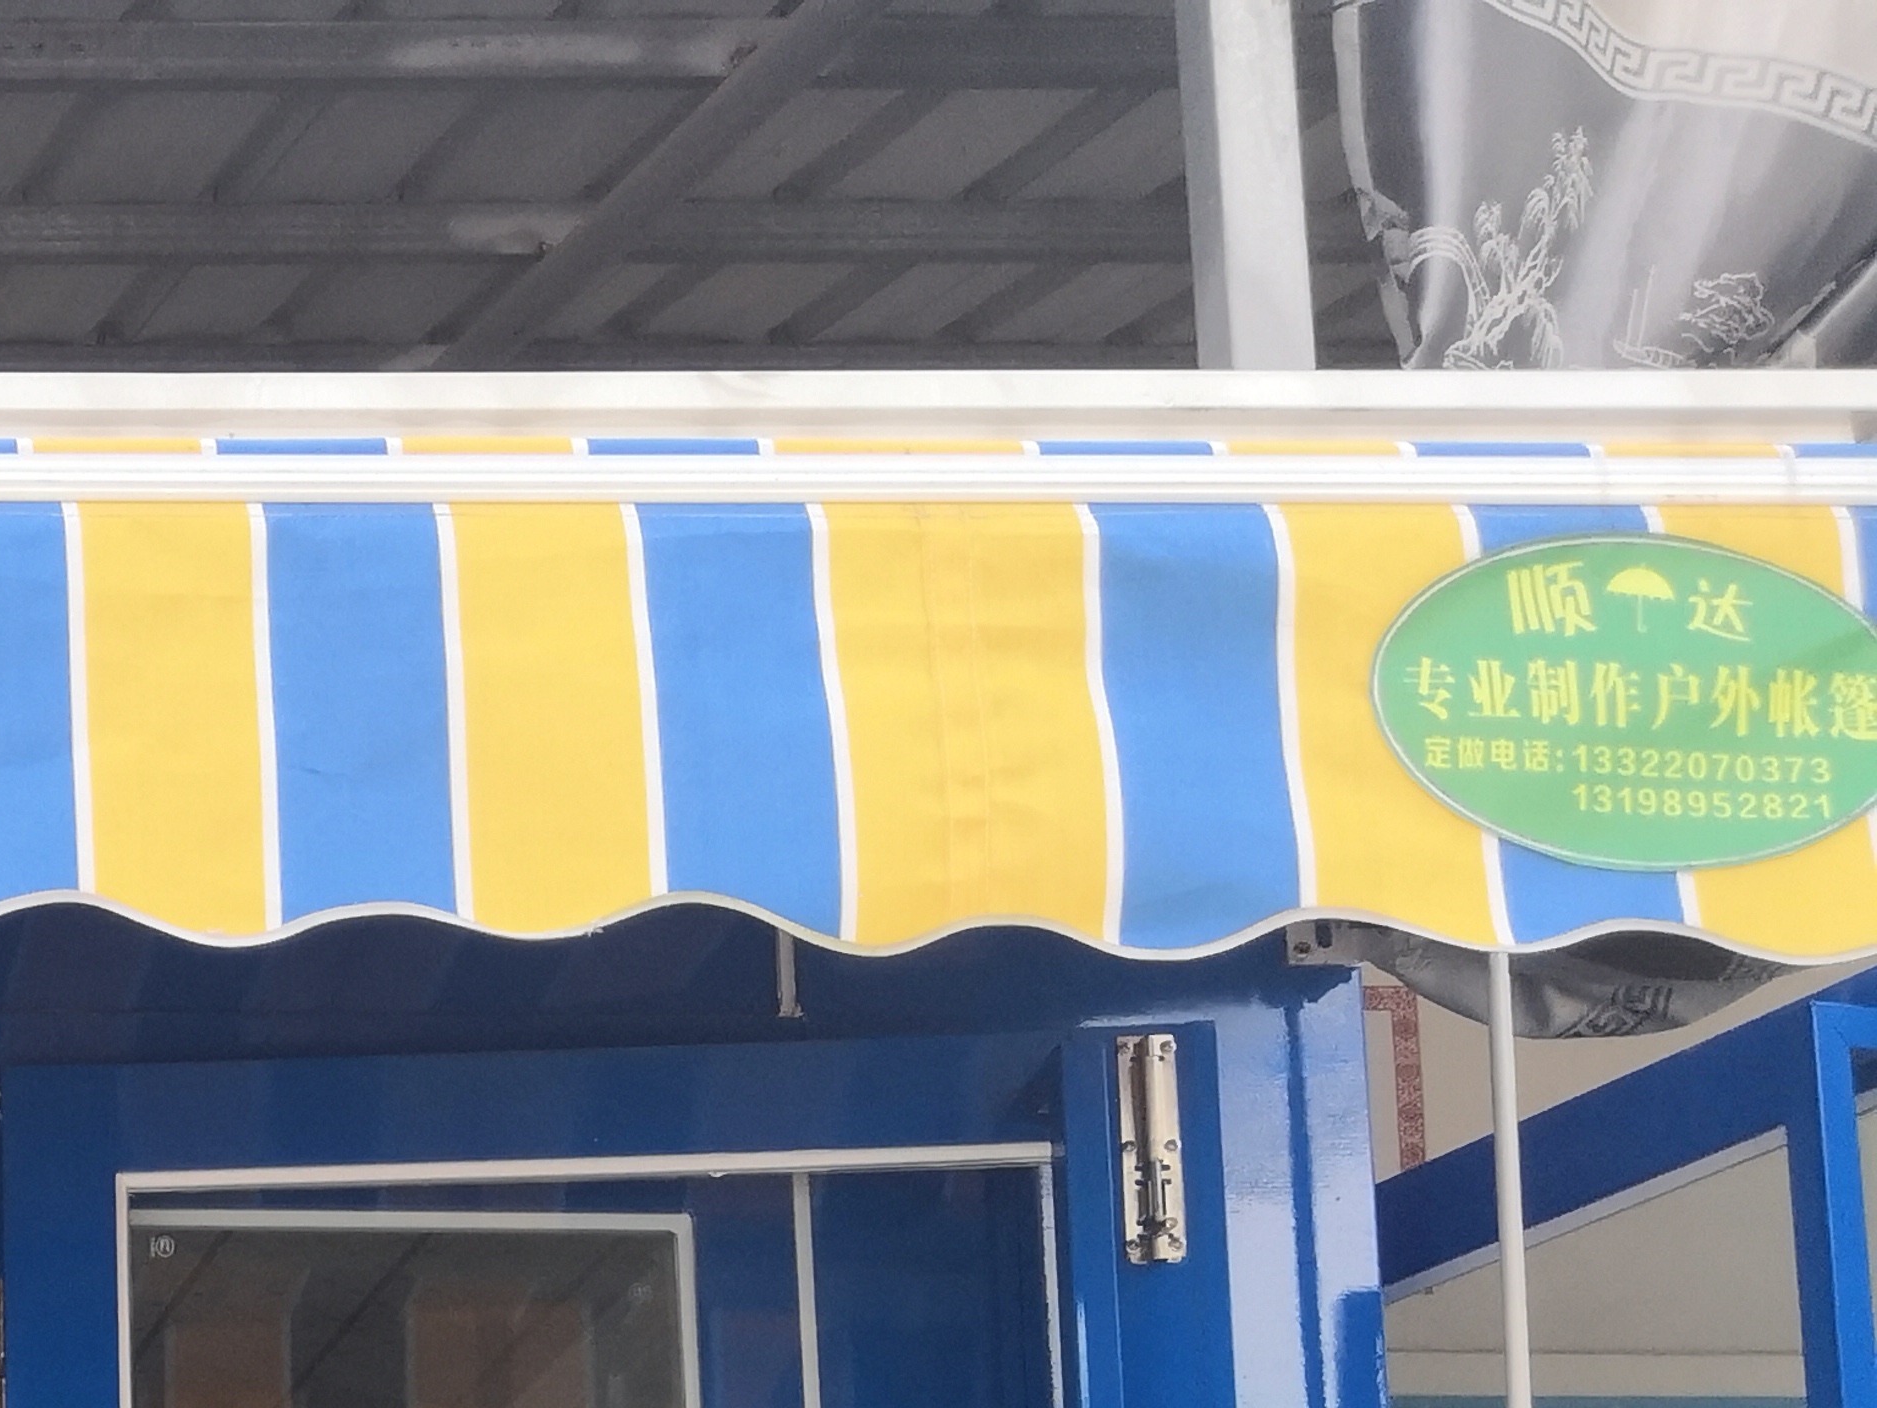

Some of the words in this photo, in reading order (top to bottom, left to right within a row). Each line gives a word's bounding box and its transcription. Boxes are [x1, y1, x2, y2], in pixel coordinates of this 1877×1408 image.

[1507, 561, 1599, 637] 顺
[1686, 578, 1754, 643] 达
[1572, 783, 1832, 820] 13198952821
